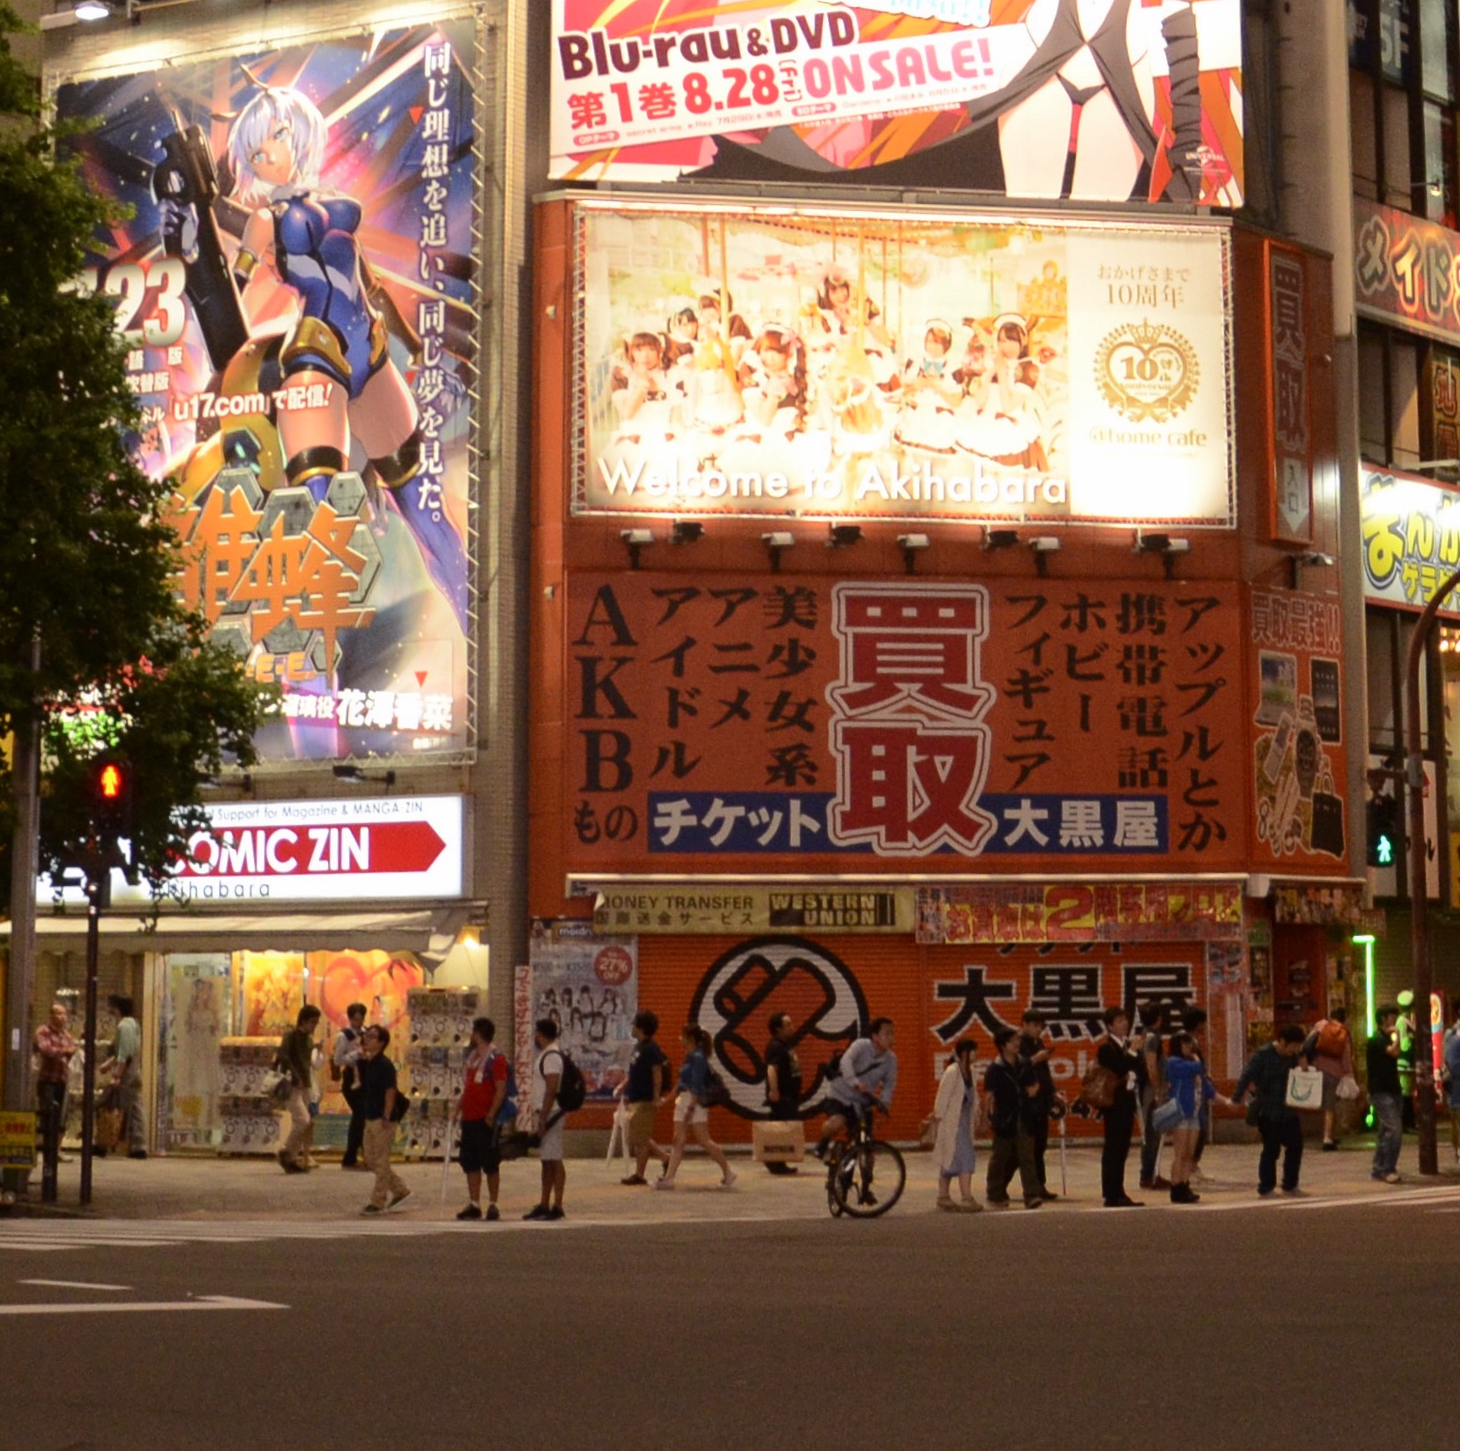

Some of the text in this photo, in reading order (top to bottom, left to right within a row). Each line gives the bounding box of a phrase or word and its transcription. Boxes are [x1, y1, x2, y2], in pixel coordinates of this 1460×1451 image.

[769, 11, 857, 52] DVD
[566, 81, 678, 132] 第1巻
[682, 63, 779, 115] 8.28
[803, 53, 867, 99] ON
[871, 37, 995, 92] SALE!
[417, 41, 453, 525] 同じ理想を追い、同じ夢を見た。
[1097, 264, 1191, 283] おかげさまで
[1107, 282, 1185, 310] 10周年
[1119, 355, 1161, 382] 10
[1271, 254, 1307, 450] 買取
[1167, 427, 1208, 448] cafe
[597, 454, 790, 500] Welcome
[856, 458, 1068, 506] Akihabara
[1285, 465, 1301, 515] 入口
[649, 585, 703, 780] アイドル
[706, 585, 762, 730] アニメ
[1058, 592, 1108, 734] ホビー
[762, 585, 820, 790] 美少女系
[1003, 592, 1057, 791] フィギュア
[1115, 592, 1169, 790] 携帯電話
[826, 583, 997, 857] 買取
[1173, 593, 1228, 854] アップルとか
[218, 806, 260, 821] Support
[264, 807, 278, 819] for
[281, 805, 338, 820] Magazine
[652, 799, 1161, 849] チケット 大黒屋
[307, 825, 370, 873] ZIN
[665, 894, 755, 911] TRANSFER
[769, 893, 877, 911] WESTERN
[804, 909, 876, 926] UNION
[598, 957, 629, 973] 27%
